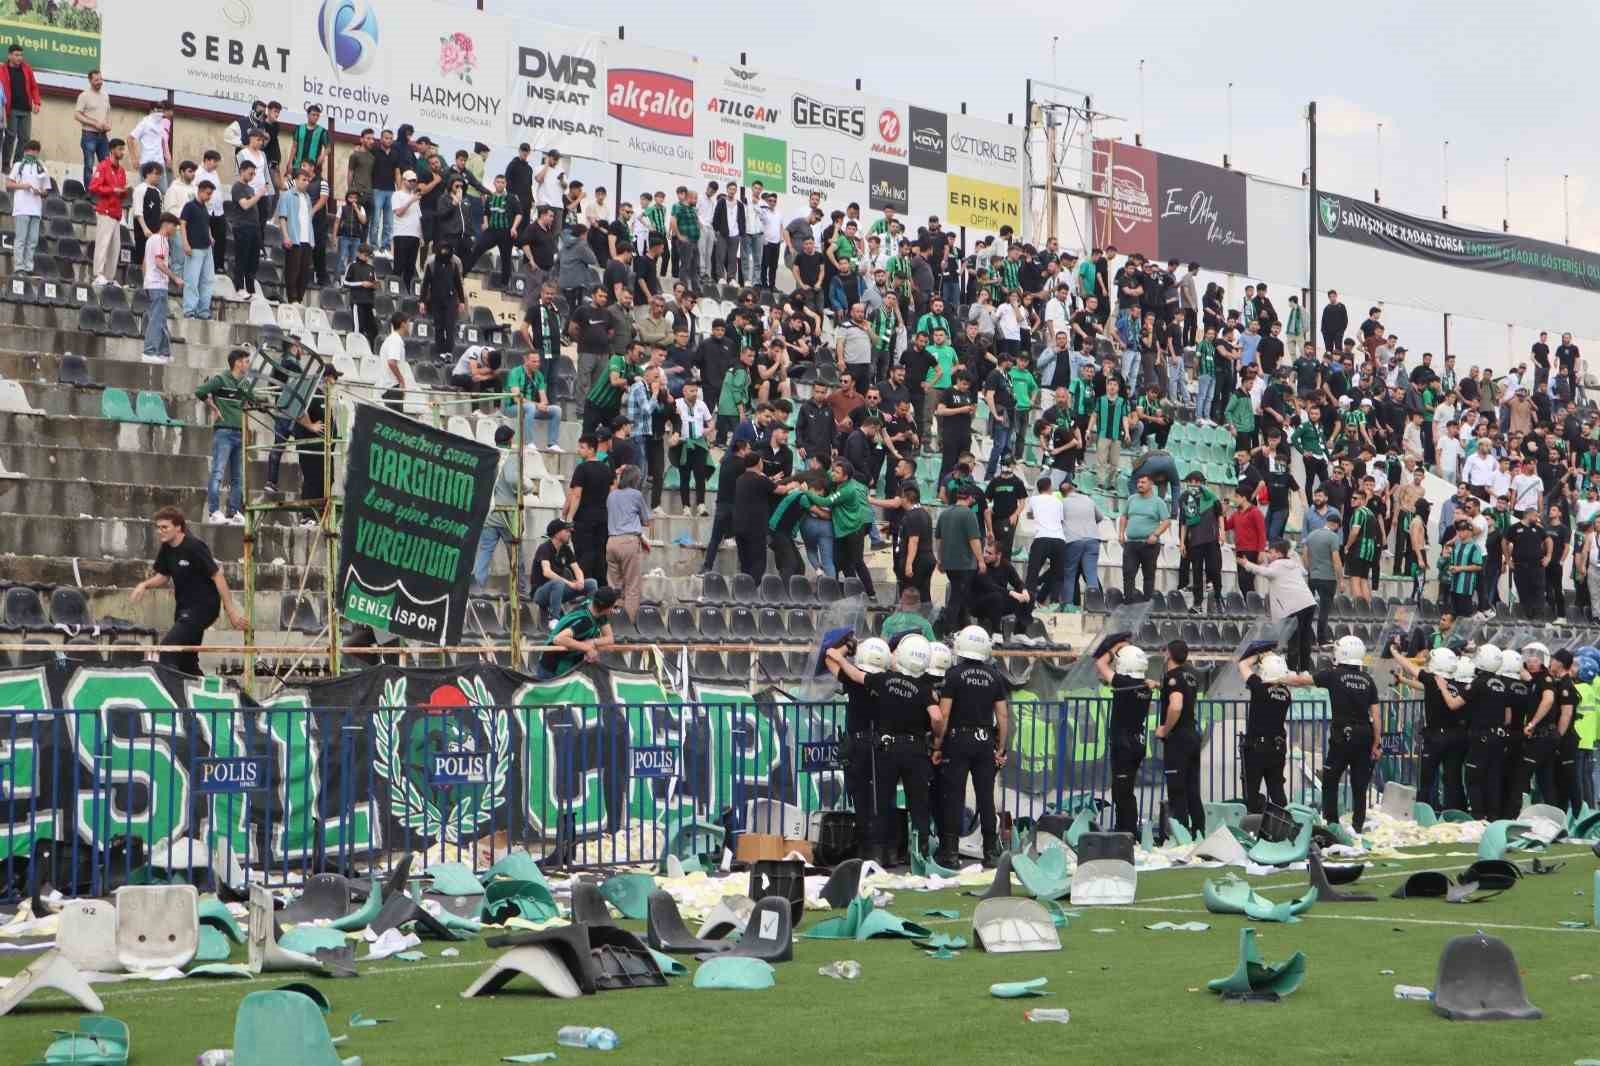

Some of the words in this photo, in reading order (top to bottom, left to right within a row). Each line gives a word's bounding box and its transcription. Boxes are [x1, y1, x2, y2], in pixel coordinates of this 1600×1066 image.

[16, 35, 48, 51] Yeşil
[52, 40, 97, 57] Lezzeti
[181, 31, 290, 73] SEBAT
[518, 46, 596, 89] DMR
[303, 75, 324, 95] biz
[328, 85, 390, 106] creative
[410, 82, 501, 116] HARMONY
[526, 81, 590, 106] İNŞAAT
[609, 80, 693, 120] akçako
[303, 100, 389, 128] company
[512, 112, 544, 129] DMR
[707, 97, 778, 123] ATILGAN
[793, 96, 865, 138] GEGES
[791, 172, 836, 189] Sustainable
[1435, 234, 1465, 254] ZORSA
